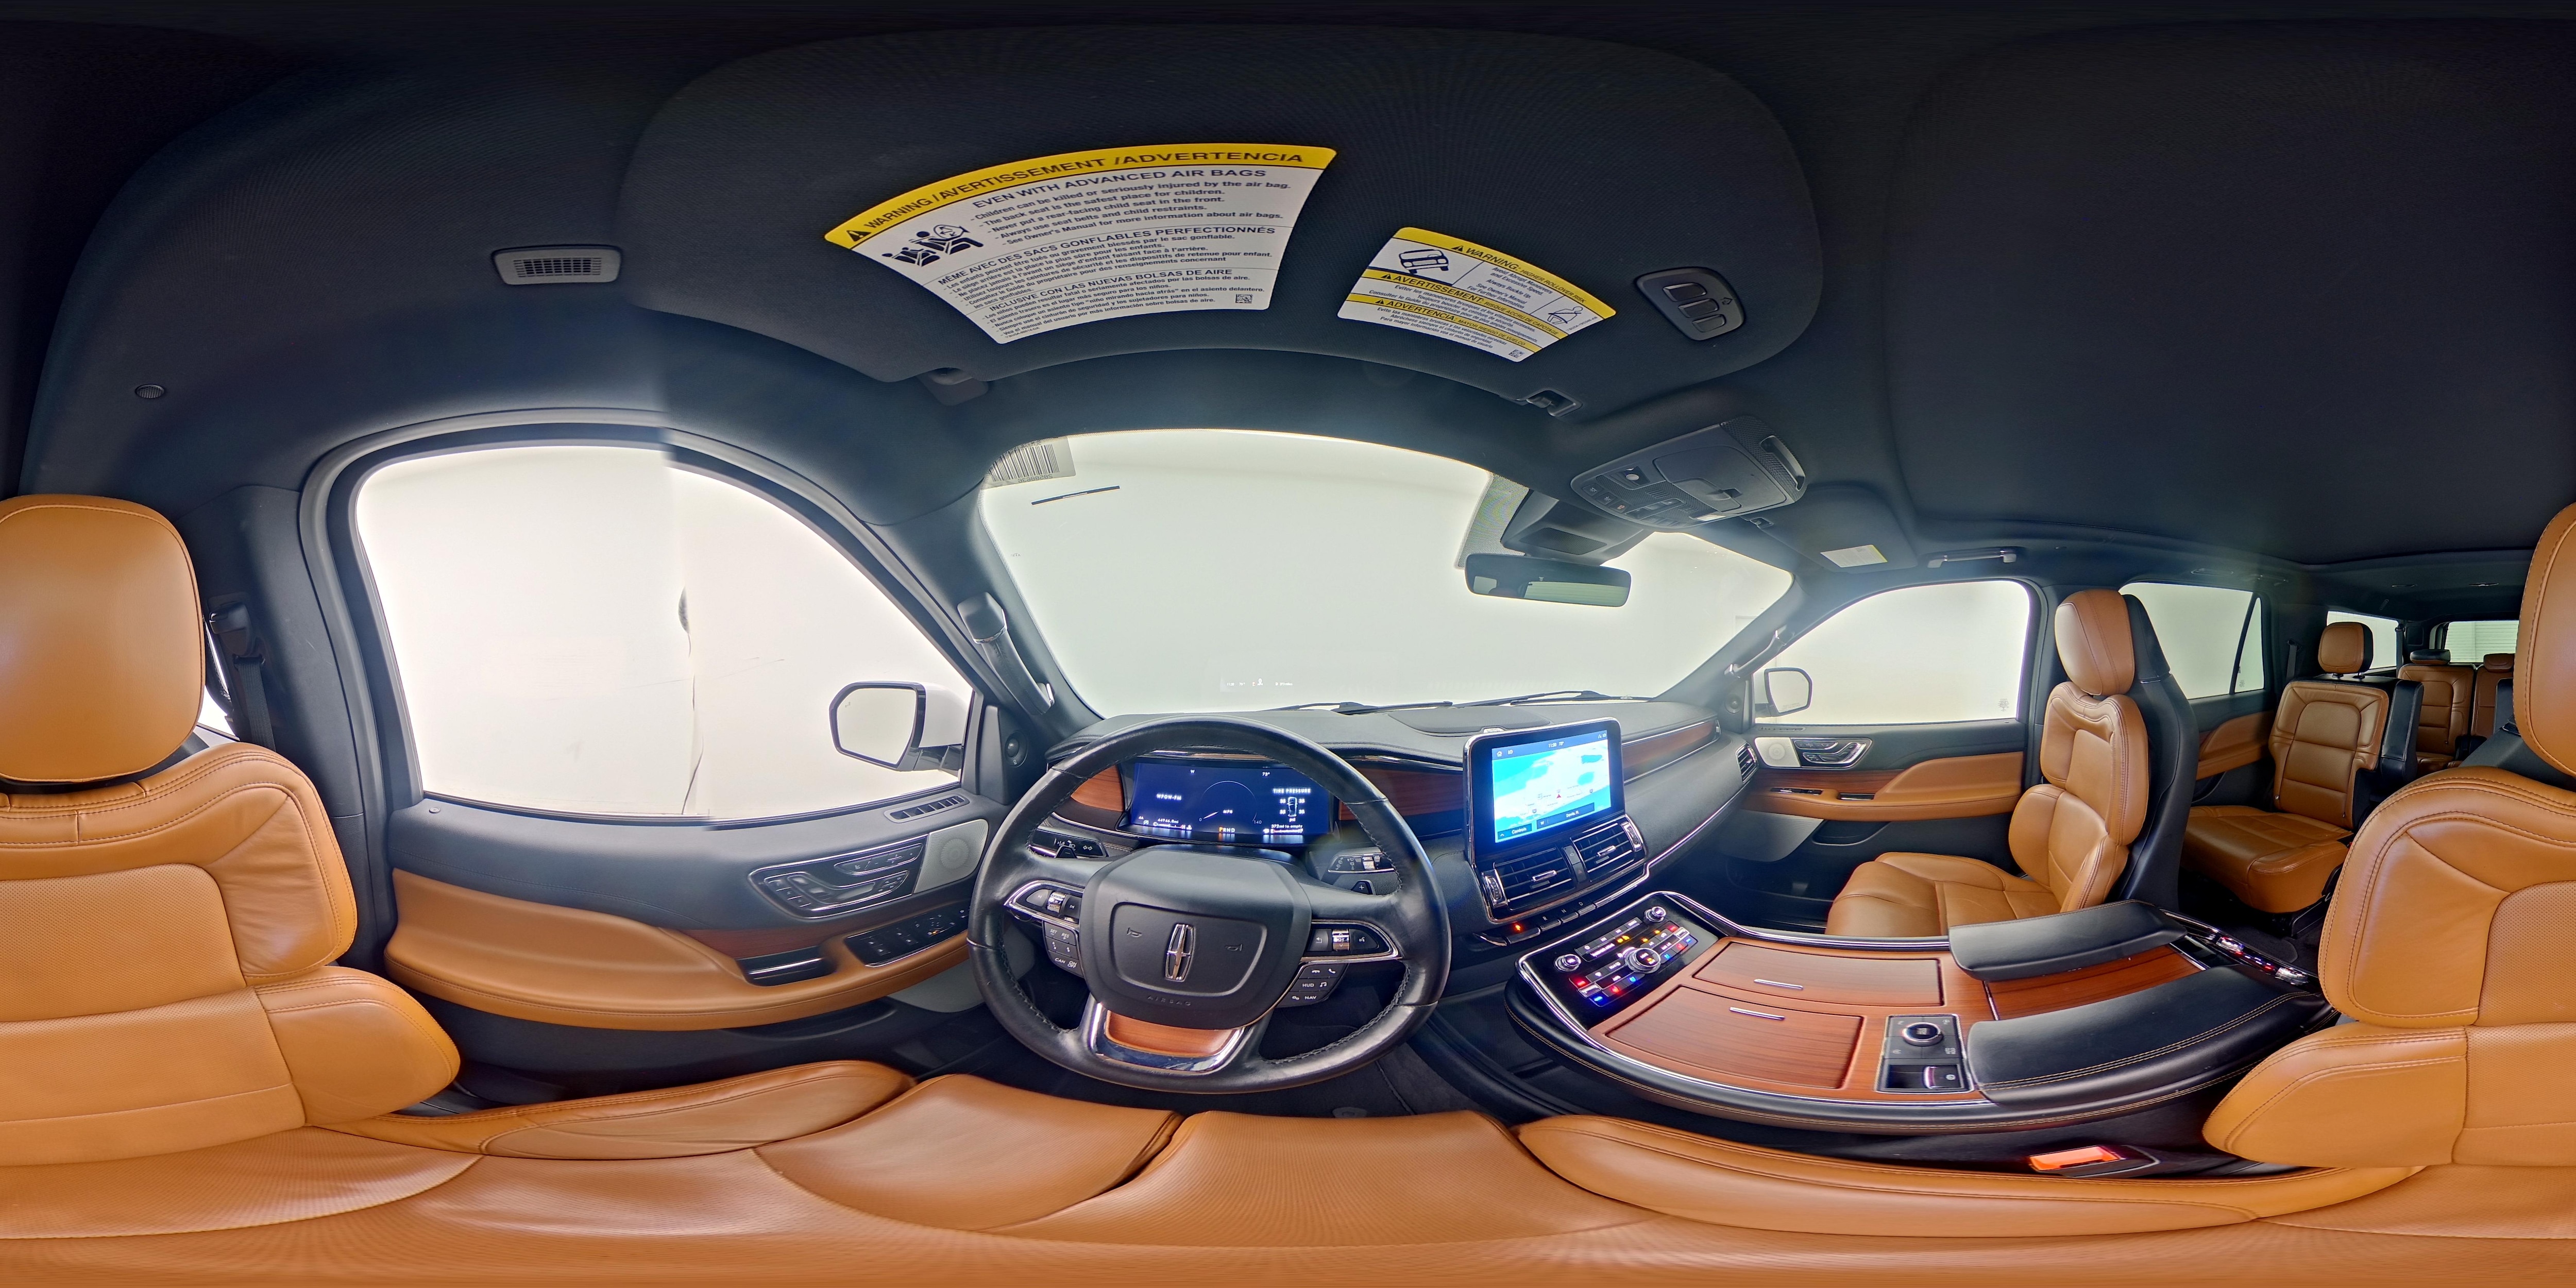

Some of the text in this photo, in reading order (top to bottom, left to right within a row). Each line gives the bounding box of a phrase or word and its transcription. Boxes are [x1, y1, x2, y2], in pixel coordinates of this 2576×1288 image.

[973, 193, 1015, 208] EVEN
[1016, 184, 1060, 196] WITH
[1065, 172, 1166, 189] ADVANCED
[975, 206, 1015, 220] Children
[1016, 200, 1035, 209] can
[1054, 192, 1083, 201] killed
[1101, 184, 1154, 194] seriously
[864, 198, 933, 229] WARNING
[991, 223, 1018, 233] Never
[1021, 218, 1036, 227] put
[1046, 206, 1101, 219] rear-facing
[1003, 212, 1027, 222] back
[1028, 207, 1050, 215] seat
[1084, 196, 1118, 204] safest
[1121, 192, 1151, 201] place
[1000, 228, 1031, 239] Always
[1075, 214, 1099, 223] belts
[1025, 230, 1060, 240] Owner's
[1061, 222, 1097, 232] Manual
[1144, 212, 1203, 221] information
[938, 227, 1276, 285] MÊME AVEC DES SACS GONFLABLES PERFECTIONNÉS
[959, 274, 985, 284] enfants
[985, 264, 1013, 277] peuvent
[1061, 244, 1106, 256] gravement
[1466, 248, 1586, 303] WARNING: HIGHER ROLLOVER RISK
[1486, 279, 1505, 288] Always
[1506, 286, 1524, 295] Buckle
[1492, 267, 1553, 294] Avoid Abrupt Maneuvers
[1502, 277, 1528, 289] Excessive
[1527, 286, 1544, 296] Speed.
[989, 293, 1039, 312] INCLUSIVE
[1040, 287, 1062, 296] CON
[1064, 283, 1086, 291] LAS
[1088, 276, 1132, 286] NUEVAS
[1136, 270, 1183, 280] BOLSAS
[1477, 289, 1497, 298] Further
[1497, 296, 1525, 309] Information
[1487, 287, 1509, 297] Owner's
[1509, 296, 1528, 304] Manual
[1484, 302, 1505, 312] RISQUE
[1506, 310, 1527, 320] ACCRU
[1532, 321, 1559, 335] CAPOTAGE
[1458, 319, 1478, 328] MAYOR
[1479, 326, 1498, 335] RIESGO
[1505, 335, 1526, 346] VUELCO
[1511, 826, 1527, 835] Controls
[1147, 995, 1191, 1006] AIRBAG
